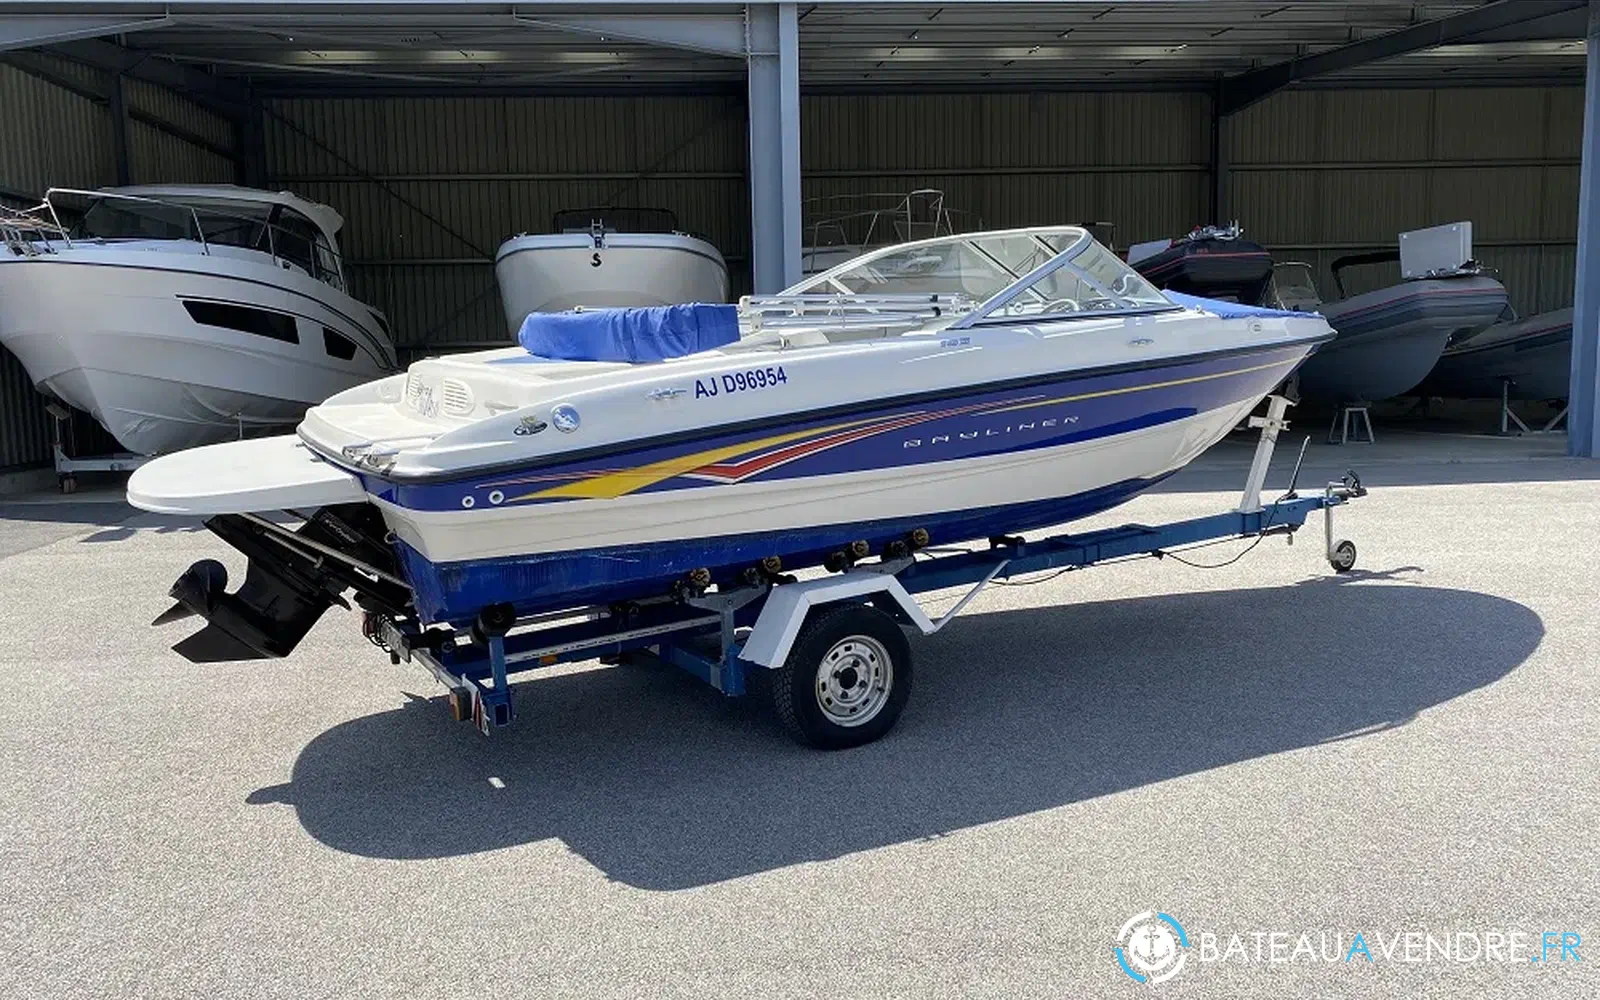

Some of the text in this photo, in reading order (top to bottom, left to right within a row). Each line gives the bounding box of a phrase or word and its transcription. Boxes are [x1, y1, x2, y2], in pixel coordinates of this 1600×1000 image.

[695, 366, 788, 399] AJ D96954
[903, 416, 1079, 448] BAYLINER
